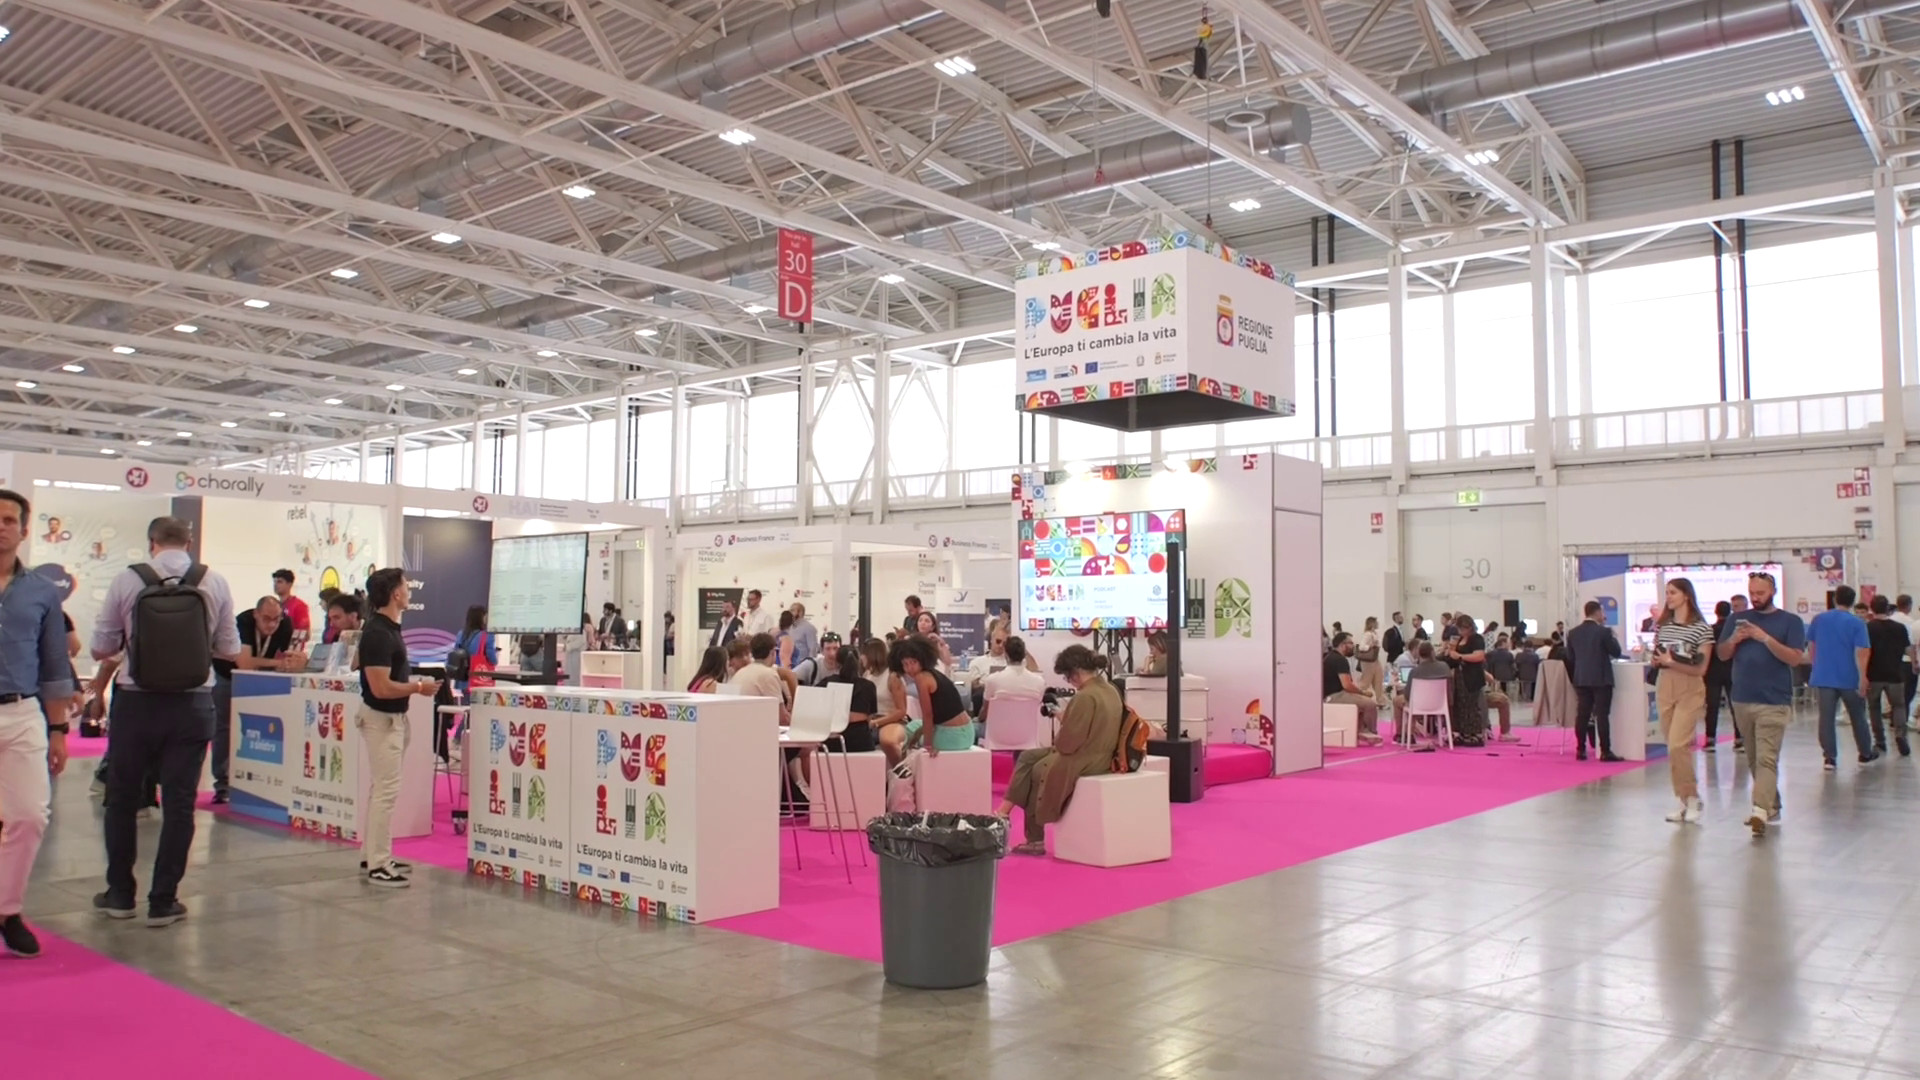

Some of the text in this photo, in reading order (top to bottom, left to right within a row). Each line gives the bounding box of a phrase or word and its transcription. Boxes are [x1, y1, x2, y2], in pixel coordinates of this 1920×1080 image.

[784, 250, 806, 274] 30
[785, 281, 807, 317] D
[1024, 272, 1177, 340] PUGLIA
[1238, 315, 1273, 340] REGIONE
[1024, 327, 1177, 360] L'Europa ti cambia la vita
[1238, 337, 1268, 355] PUGLIA
[198, 473, 264, 497] chorally
[1462, 558, 1491, 579] 30
[473, 823, 563, 850] L'Europa ti cambia la vita
[576, 843, 612, 861] L'Europa
[615, 849, 622, 861] ti
[624, 850, 657, 869] cambia
[658, 857, 667, 869] la
[669, 859, 688, 875] vita
